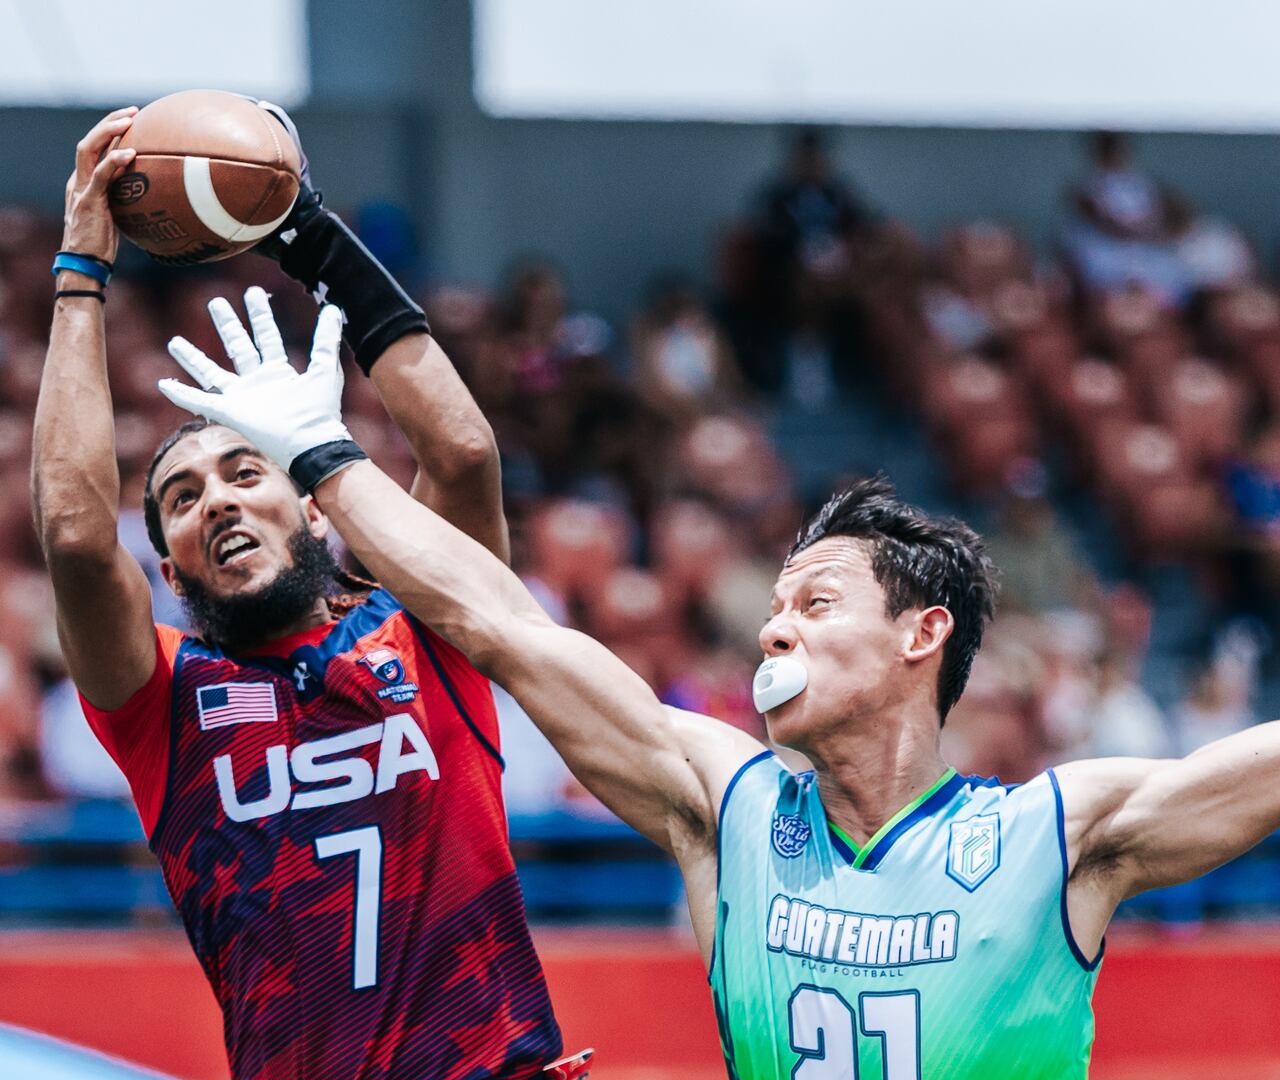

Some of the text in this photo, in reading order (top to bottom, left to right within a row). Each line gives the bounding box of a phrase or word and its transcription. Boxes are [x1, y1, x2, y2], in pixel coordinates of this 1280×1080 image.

[213, 712, 440, 823] USA
[315, 825, 383, 990] 7
[767, 894, 960, 967] GUATEMALA
[833, 966, 904, 978] FOOTBALL
